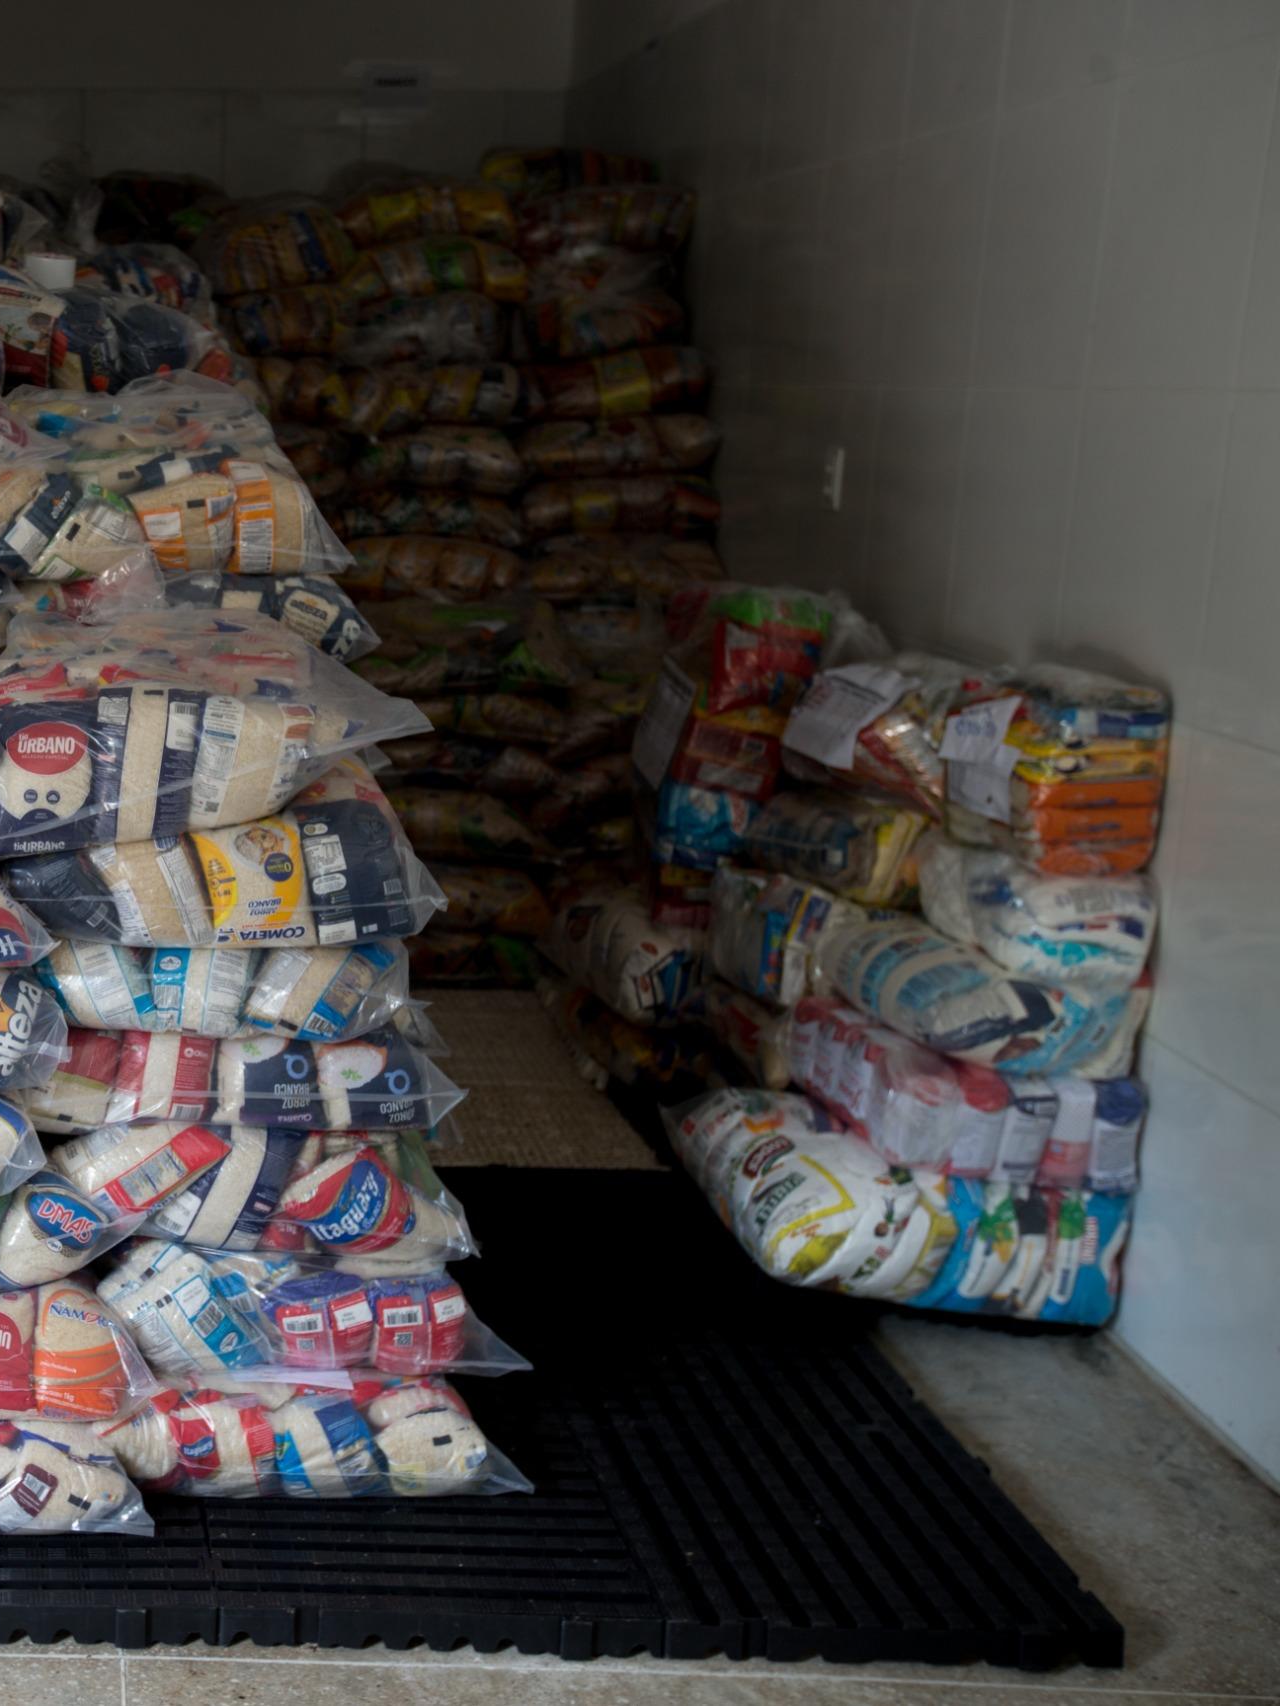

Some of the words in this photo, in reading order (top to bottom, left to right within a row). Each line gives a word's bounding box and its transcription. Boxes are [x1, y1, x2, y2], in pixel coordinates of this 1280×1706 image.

[18, 735, 76, 756] URBANO
[240, 925, 306, 941] COMETA
[274, 1083, 311, 1096] BRANCO
[309, 1168, 379, 1243] Itaguary
